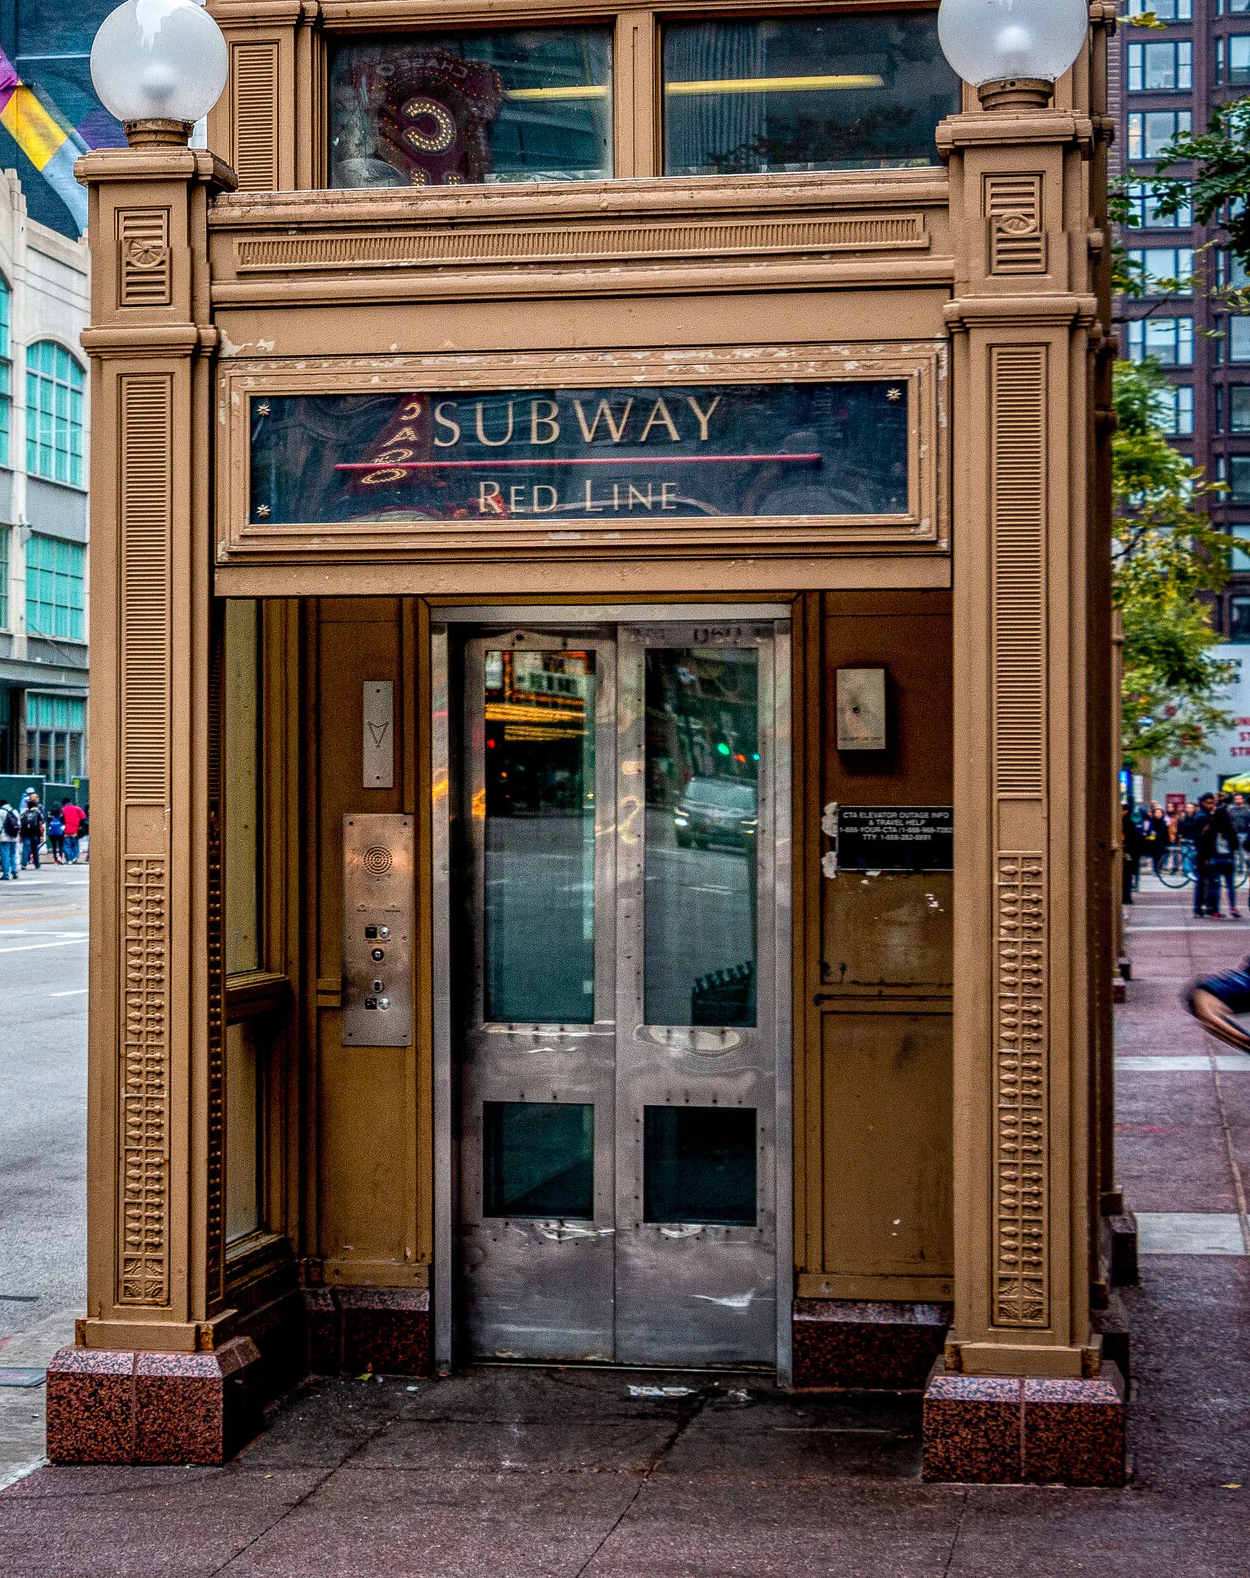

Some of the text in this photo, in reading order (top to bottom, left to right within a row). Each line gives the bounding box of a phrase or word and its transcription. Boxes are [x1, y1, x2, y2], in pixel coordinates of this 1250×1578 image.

[433, 395, 722, 448] SUBWAY
[479, 479, 677, 514] RED LINE
